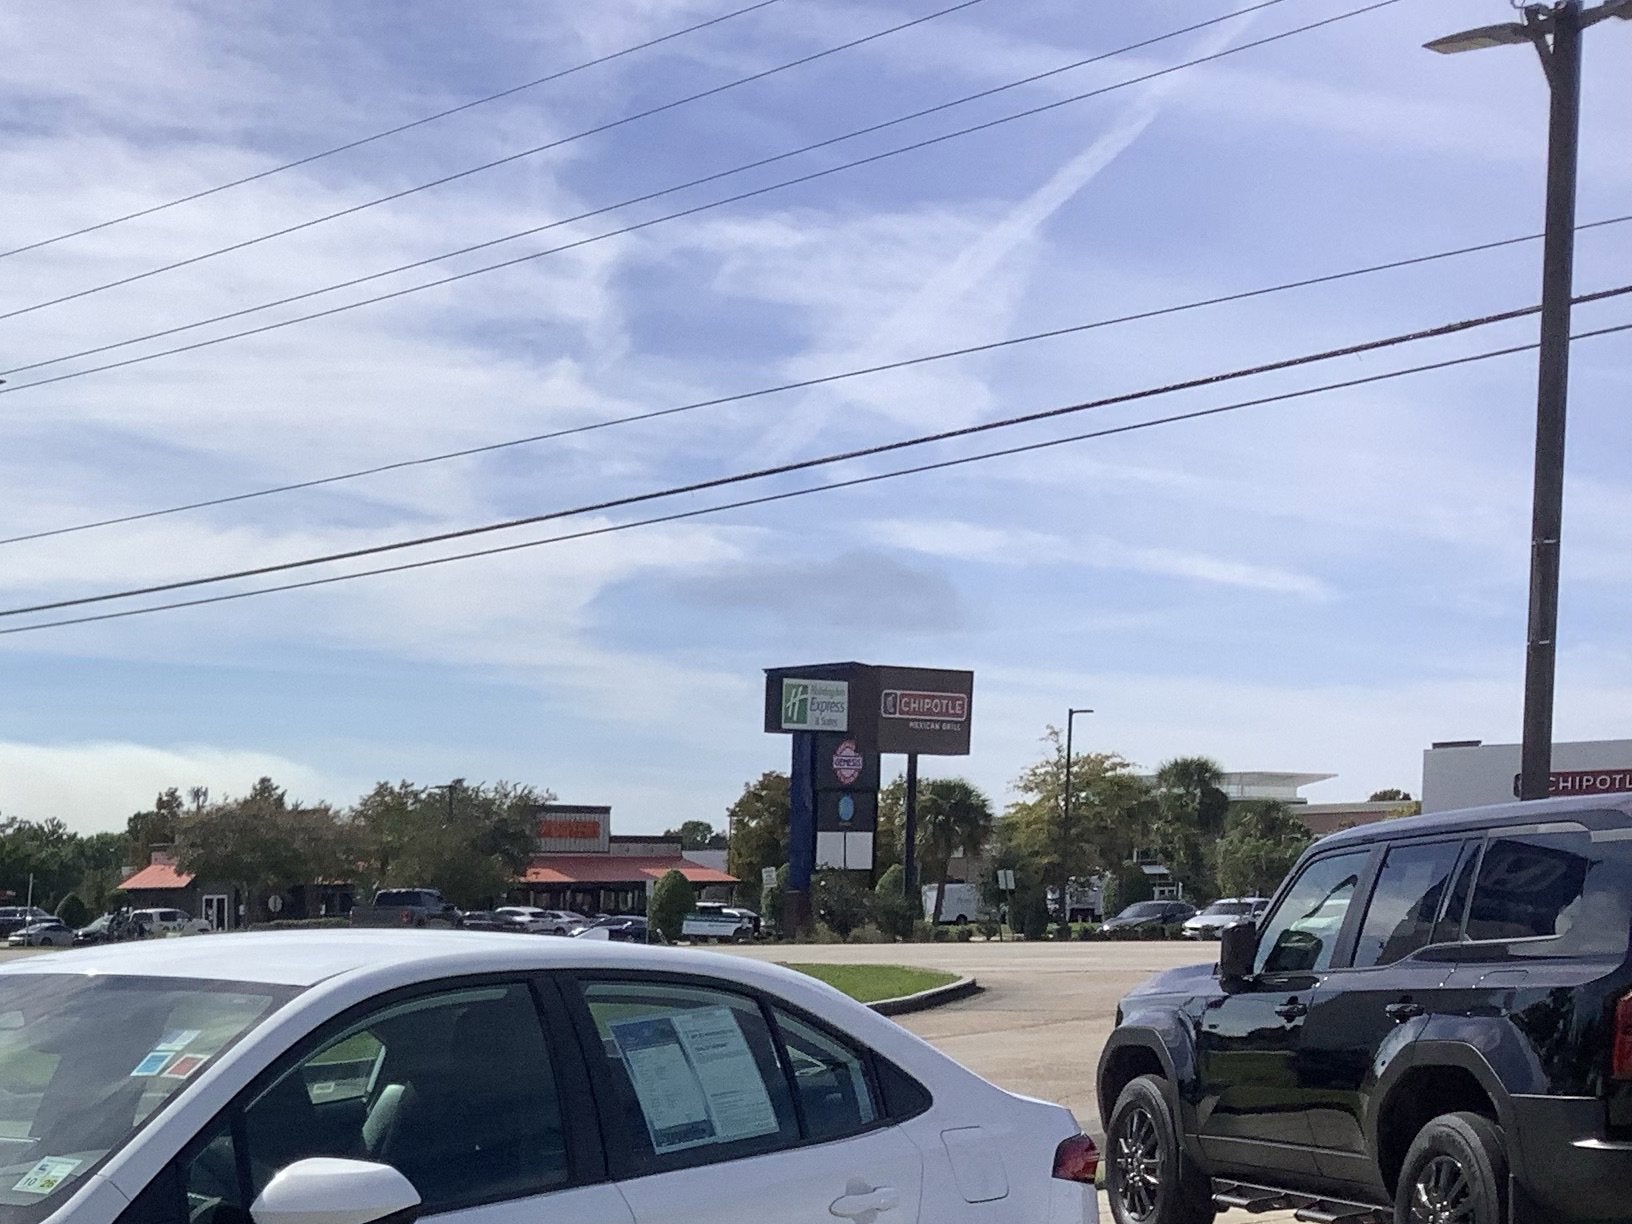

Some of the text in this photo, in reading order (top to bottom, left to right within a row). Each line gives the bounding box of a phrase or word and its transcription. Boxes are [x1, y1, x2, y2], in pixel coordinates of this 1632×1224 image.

[810, 697, 845, 715] Express
[901, 698, 964, 714] CHIPOTLE
[909, 721, 961, 731] MEXICAN GRILL
